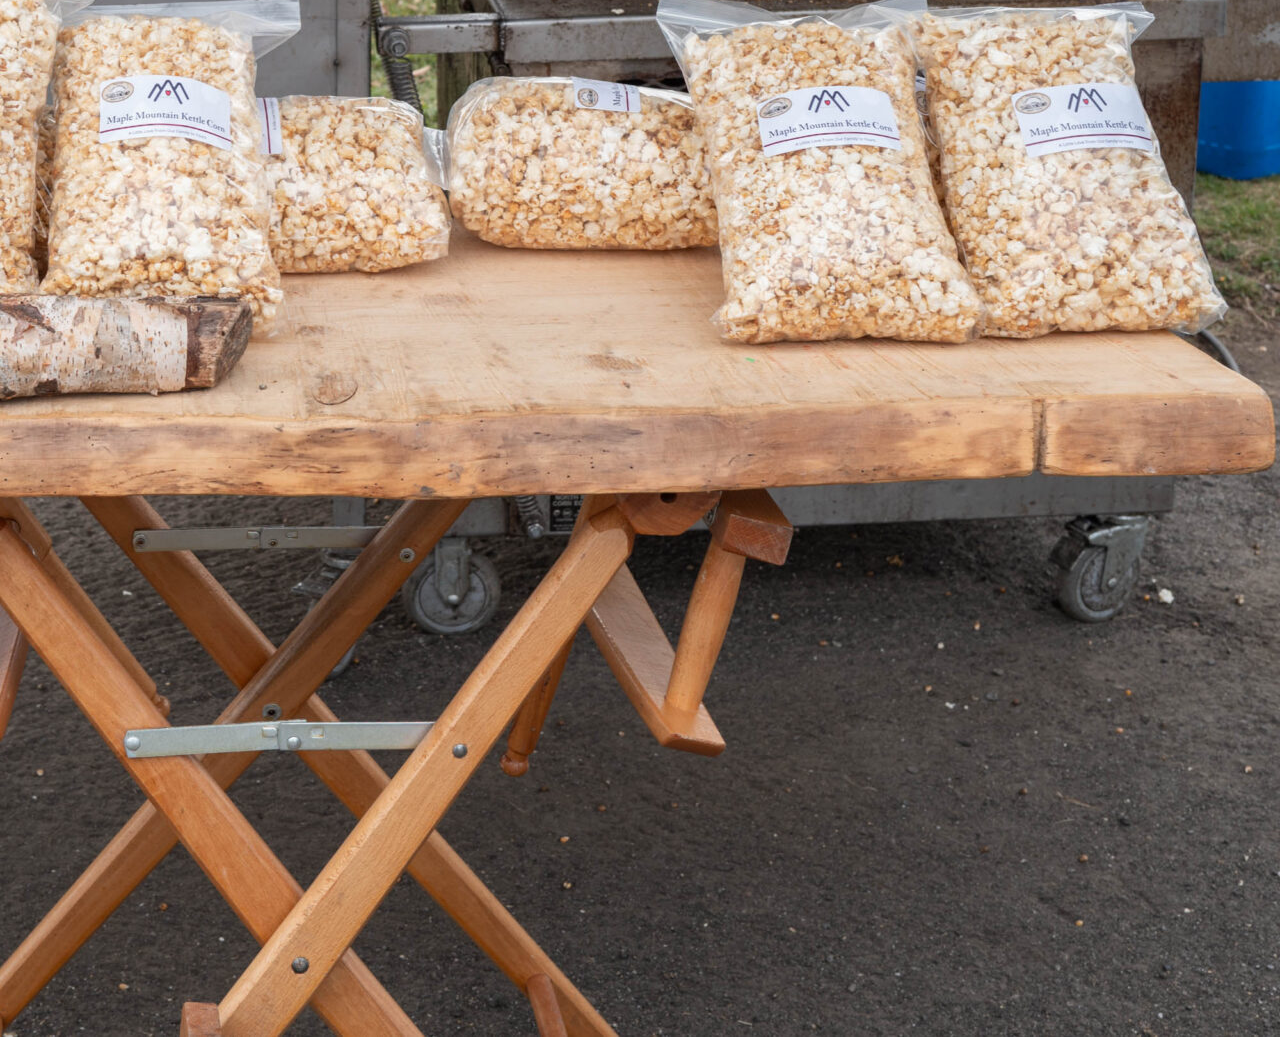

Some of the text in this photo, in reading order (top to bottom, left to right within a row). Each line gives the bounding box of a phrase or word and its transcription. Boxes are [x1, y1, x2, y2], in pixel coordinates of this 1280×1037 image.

[106, 111, 226, 133] Maple Mountain Kettle Corn
[768, 119, 893, 138] Maple Mountain Kettle Corn
[1030, 125, 1059, 137] Maple
[1060, 120, 1104, 131] Mountain
[1105, 120, 1128, 129] Kettle
